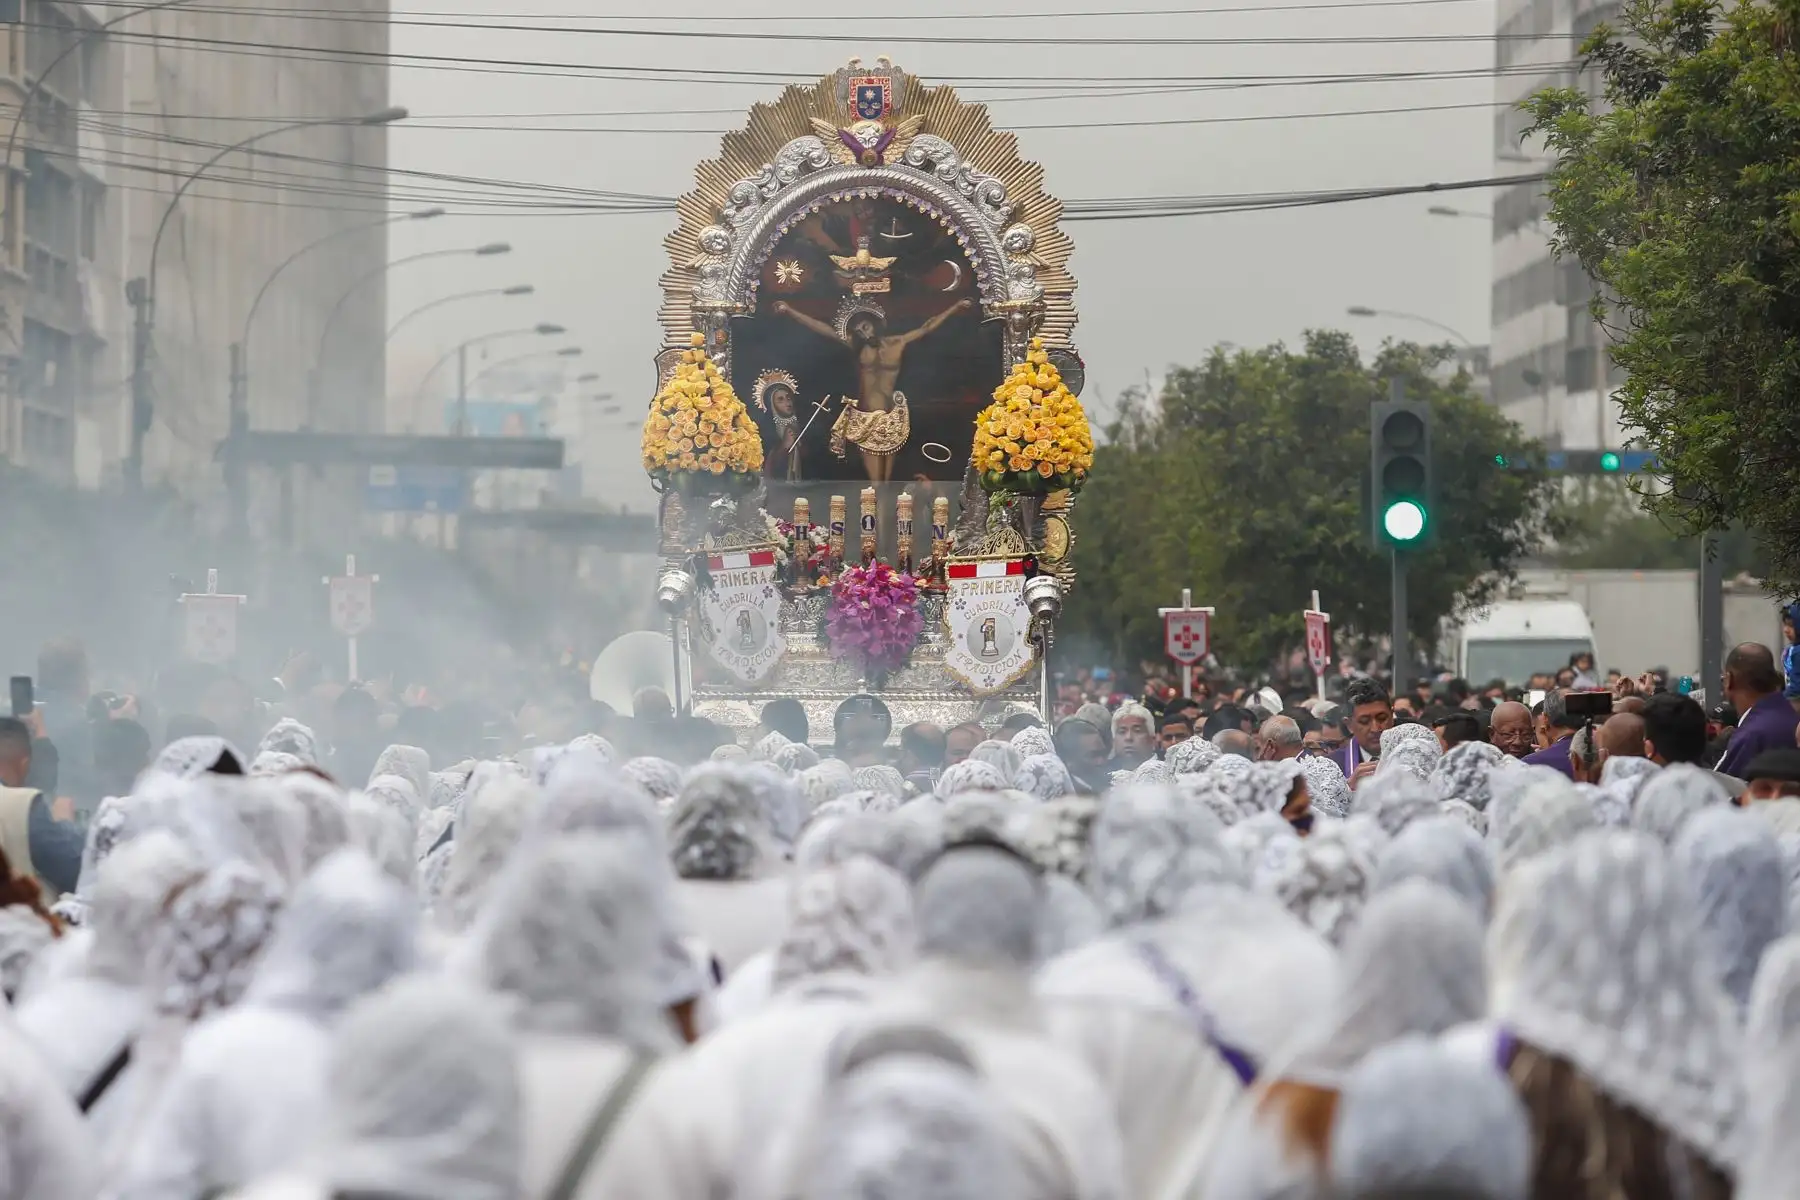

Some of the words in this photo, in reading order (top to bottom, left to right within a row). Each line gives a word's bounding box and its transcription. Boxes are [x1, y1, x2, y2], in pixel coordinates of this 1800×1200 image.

[795, 526, 807, 540] H
[831, 522, 844, 536] S
[899, 521, 912, 535] M
[932, 525, 945, 539] N
[713, 571, 768, 588] PRIMERA
[961, 580, 1021, 596] PRIMERA
[720, 592, 765, 612] CUADRILLA
[964, 601, 1017, 620] CUADRILLA
[718, 643, 778, 667] TRADICION
[956, 650, 1023, 675] TRADICION
